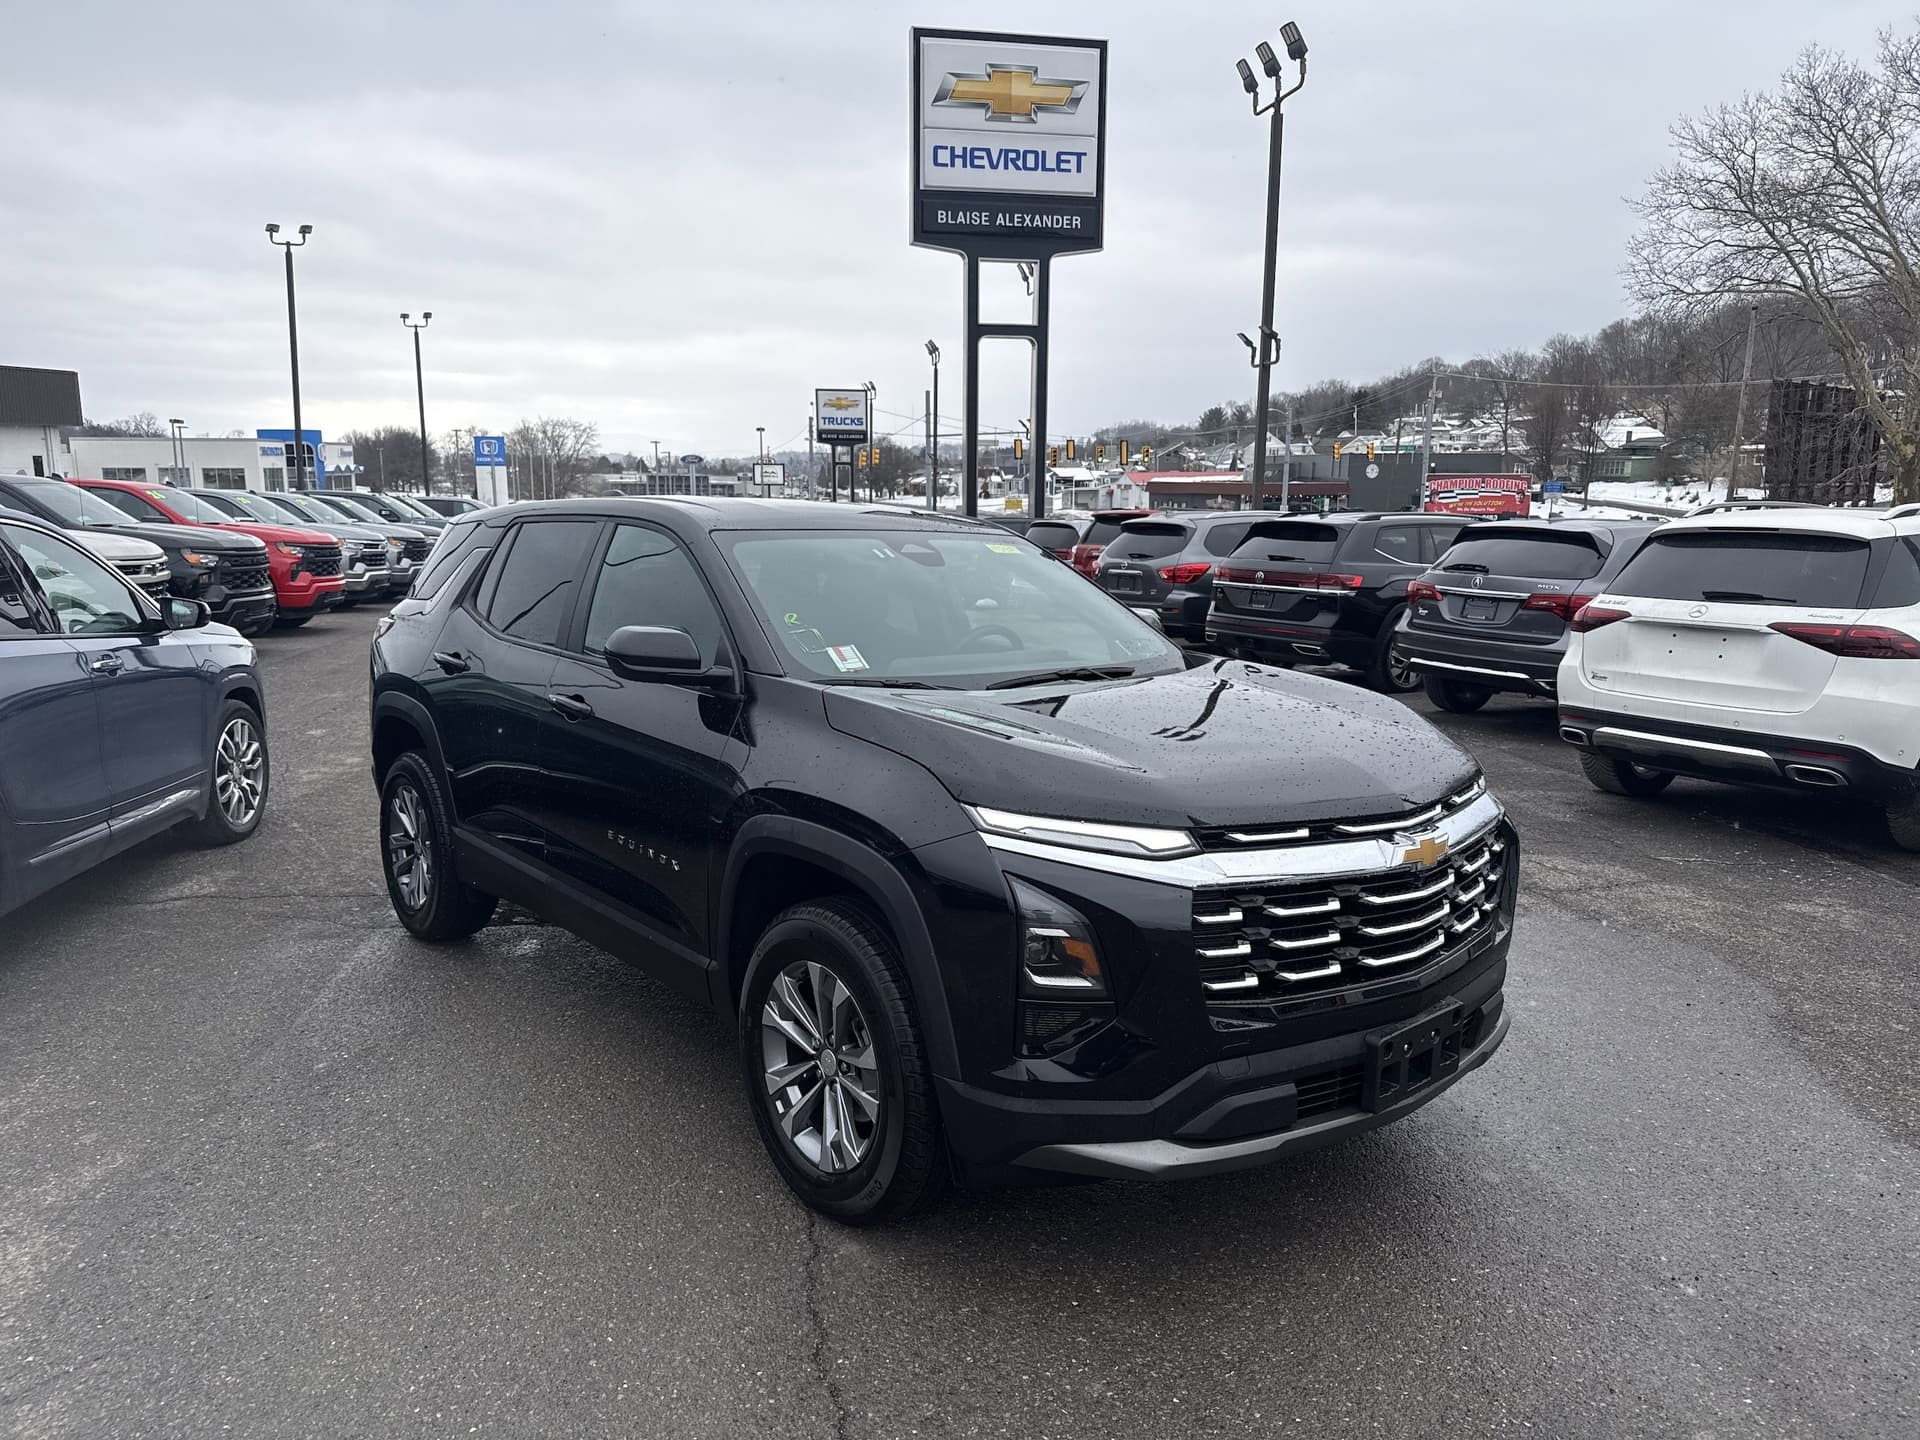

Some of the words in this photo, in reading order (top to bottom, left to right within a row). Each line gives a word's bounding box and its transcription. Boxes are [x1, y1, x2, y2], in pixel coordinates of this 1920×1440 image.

[932, 144, 1087, 174] CHEVROLET
[937, 209, 990, 225] BLAISE
[996, 212, 1081, 229] ALEXANDER
[821, 416, 864, 426] TRUCKS
[1430, 478, 1481, 491] CHAMPION
[1484, 478, 1528, 491] ROOFING
[607, 829, 681, 871] EQUINOX
